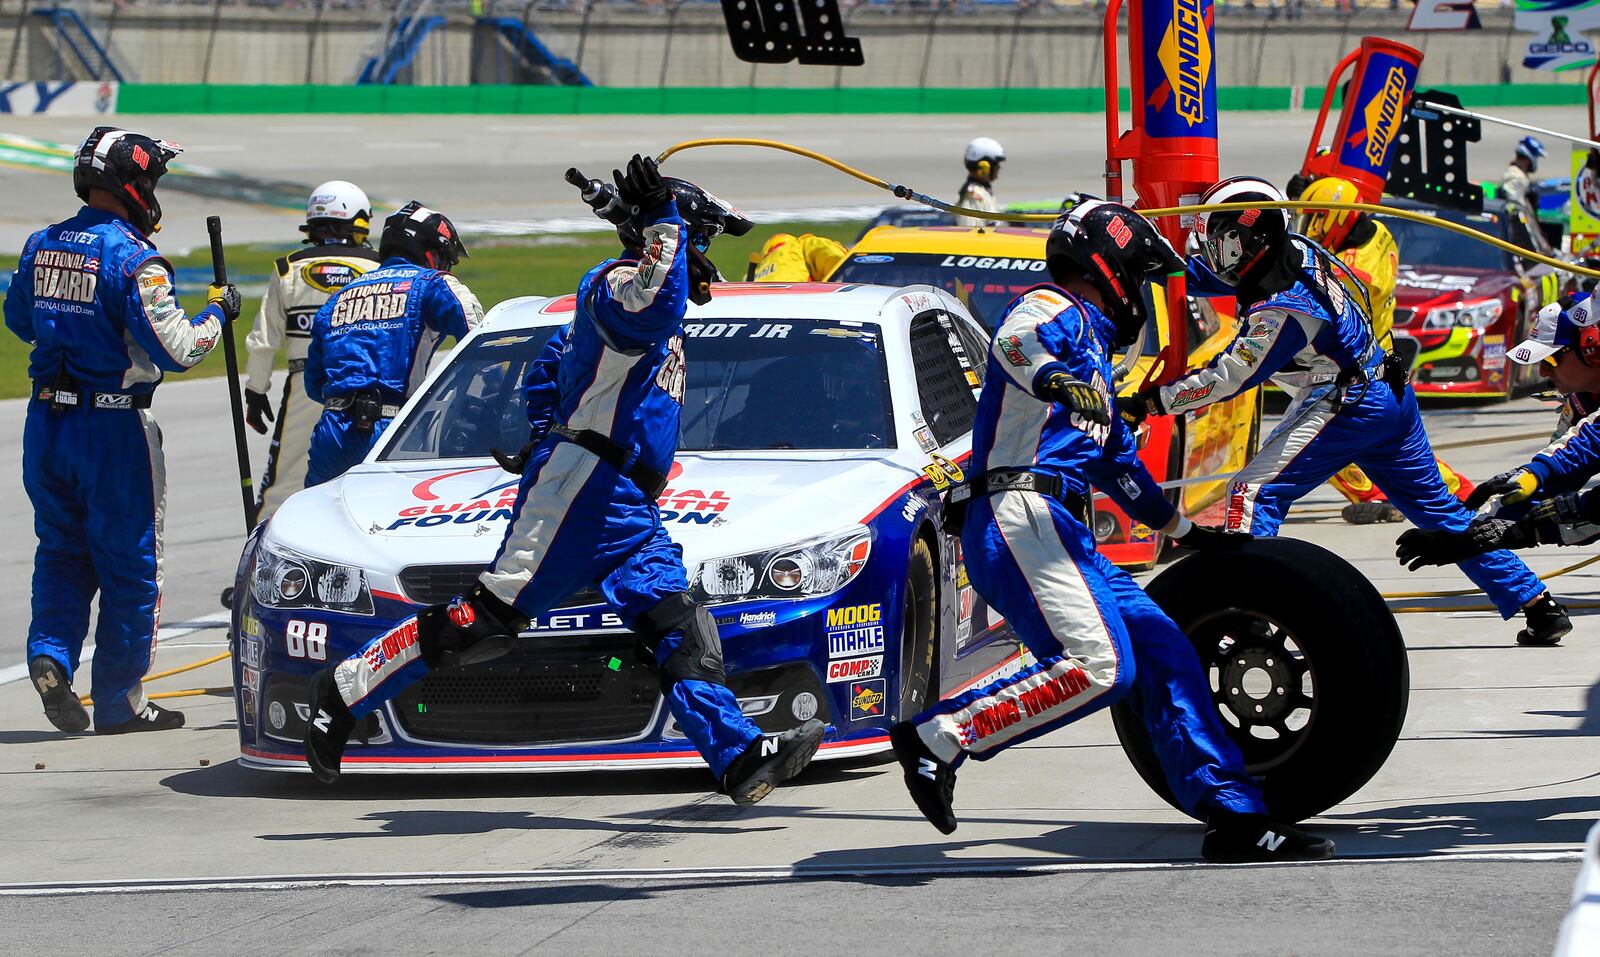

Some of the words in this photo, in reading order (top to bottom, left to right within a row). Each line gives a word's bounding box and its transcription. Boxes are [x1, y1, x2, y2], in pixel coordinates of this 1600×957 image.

[1529, 42, 1589, 54] GEICO
[1369, 71, 1404, 166] SUNOCO
[132, 145, 149, 170] 88
[59, 230, 99, 244] COVEY
[1107, 216, 1132, 248] 88
[34, 250, 86, 269] NATIONAL
[940, 255, 1047, 272] LOGANO
[321, 266, 351, 275] NASCAR
[326, 273, 353, 285] Sprint
[33, 266, 97, 303] GUARD
[337, 282, 394, 302] NATIONAL
[330, 293, 407, 328] GUARD
[749, 323, 793, 339] JR
[1515, 347, 1531, 362] 88
[739, 611, 777, 625] Hendrick
[825, 603, 881, 628] MOOG
[286, 619, 328, 661] 88
[829, 627, 883, 653] MAHLE
[829, 660, 870, 679] COMP
[857, 669, 876, 678] CAMS
[853, 693, 884, 706] SUNOCO
[1018, 667, 1092, 718] NATIONAL
[972, 698, 1022, 740] GUARD
[761, 736, 778, 757] N
[918, 757, 938, 781] N
[1257, 831, 1286, 851] N
